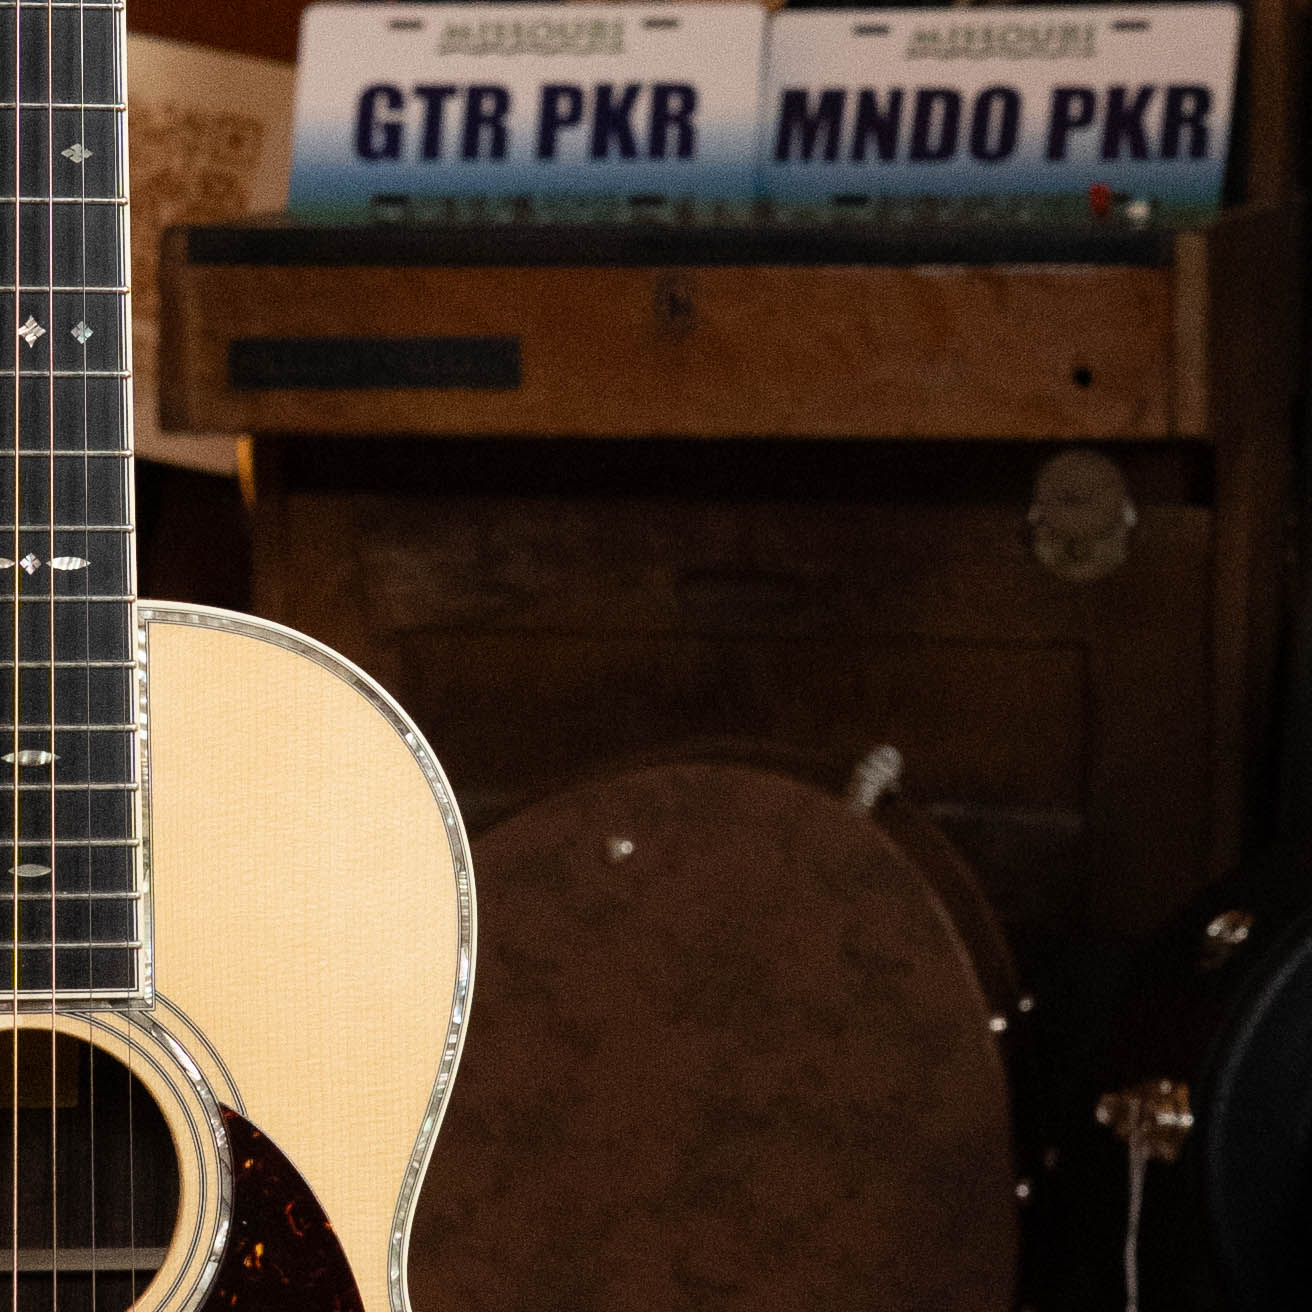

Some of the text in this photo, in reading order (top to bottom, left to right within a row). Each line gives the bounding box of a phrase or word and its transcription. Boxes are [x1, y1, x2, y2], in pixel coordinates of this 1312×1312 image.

[352, 82, 701, 165] GTR PKR
[773, 84, 1216, 166] MNDO PKR
